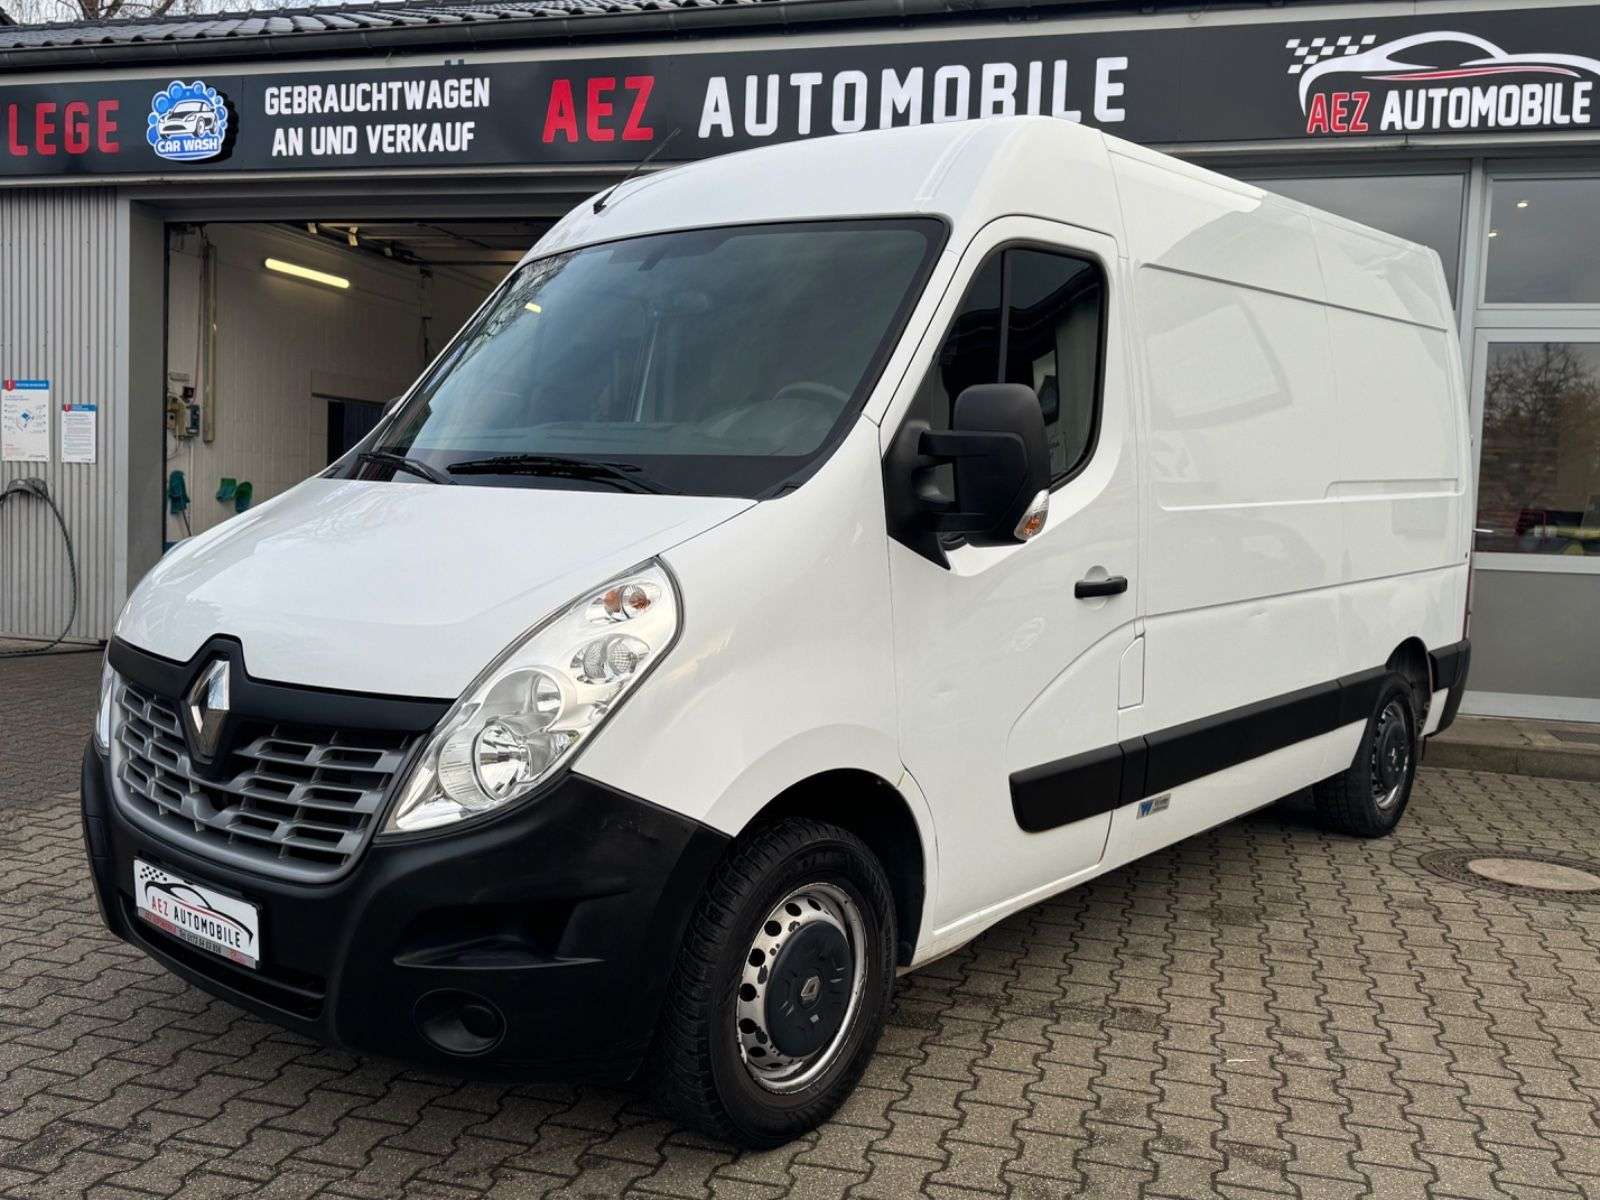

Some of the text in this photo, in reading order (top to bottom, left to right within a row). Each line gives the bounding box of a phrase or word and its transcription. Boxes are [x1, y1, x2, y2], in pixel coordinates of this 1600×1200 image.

[265, 77, 490, 115] GEBRAUCHTWAGEN
[542, 56, 1128, 143] AEZ AUTOMOBILE
[1306, 81, 1593, 134] AEZ AUTOMOBILE
[8, 99, 120, 156] LEGE
[157, 138, 218, 152] CAR WASH
[272, 121, 475, 156] AN UND VERKAUF
[151, 895, 169, 917] AEZ
[174, 905, 241, 948] AUTOMOBILE
